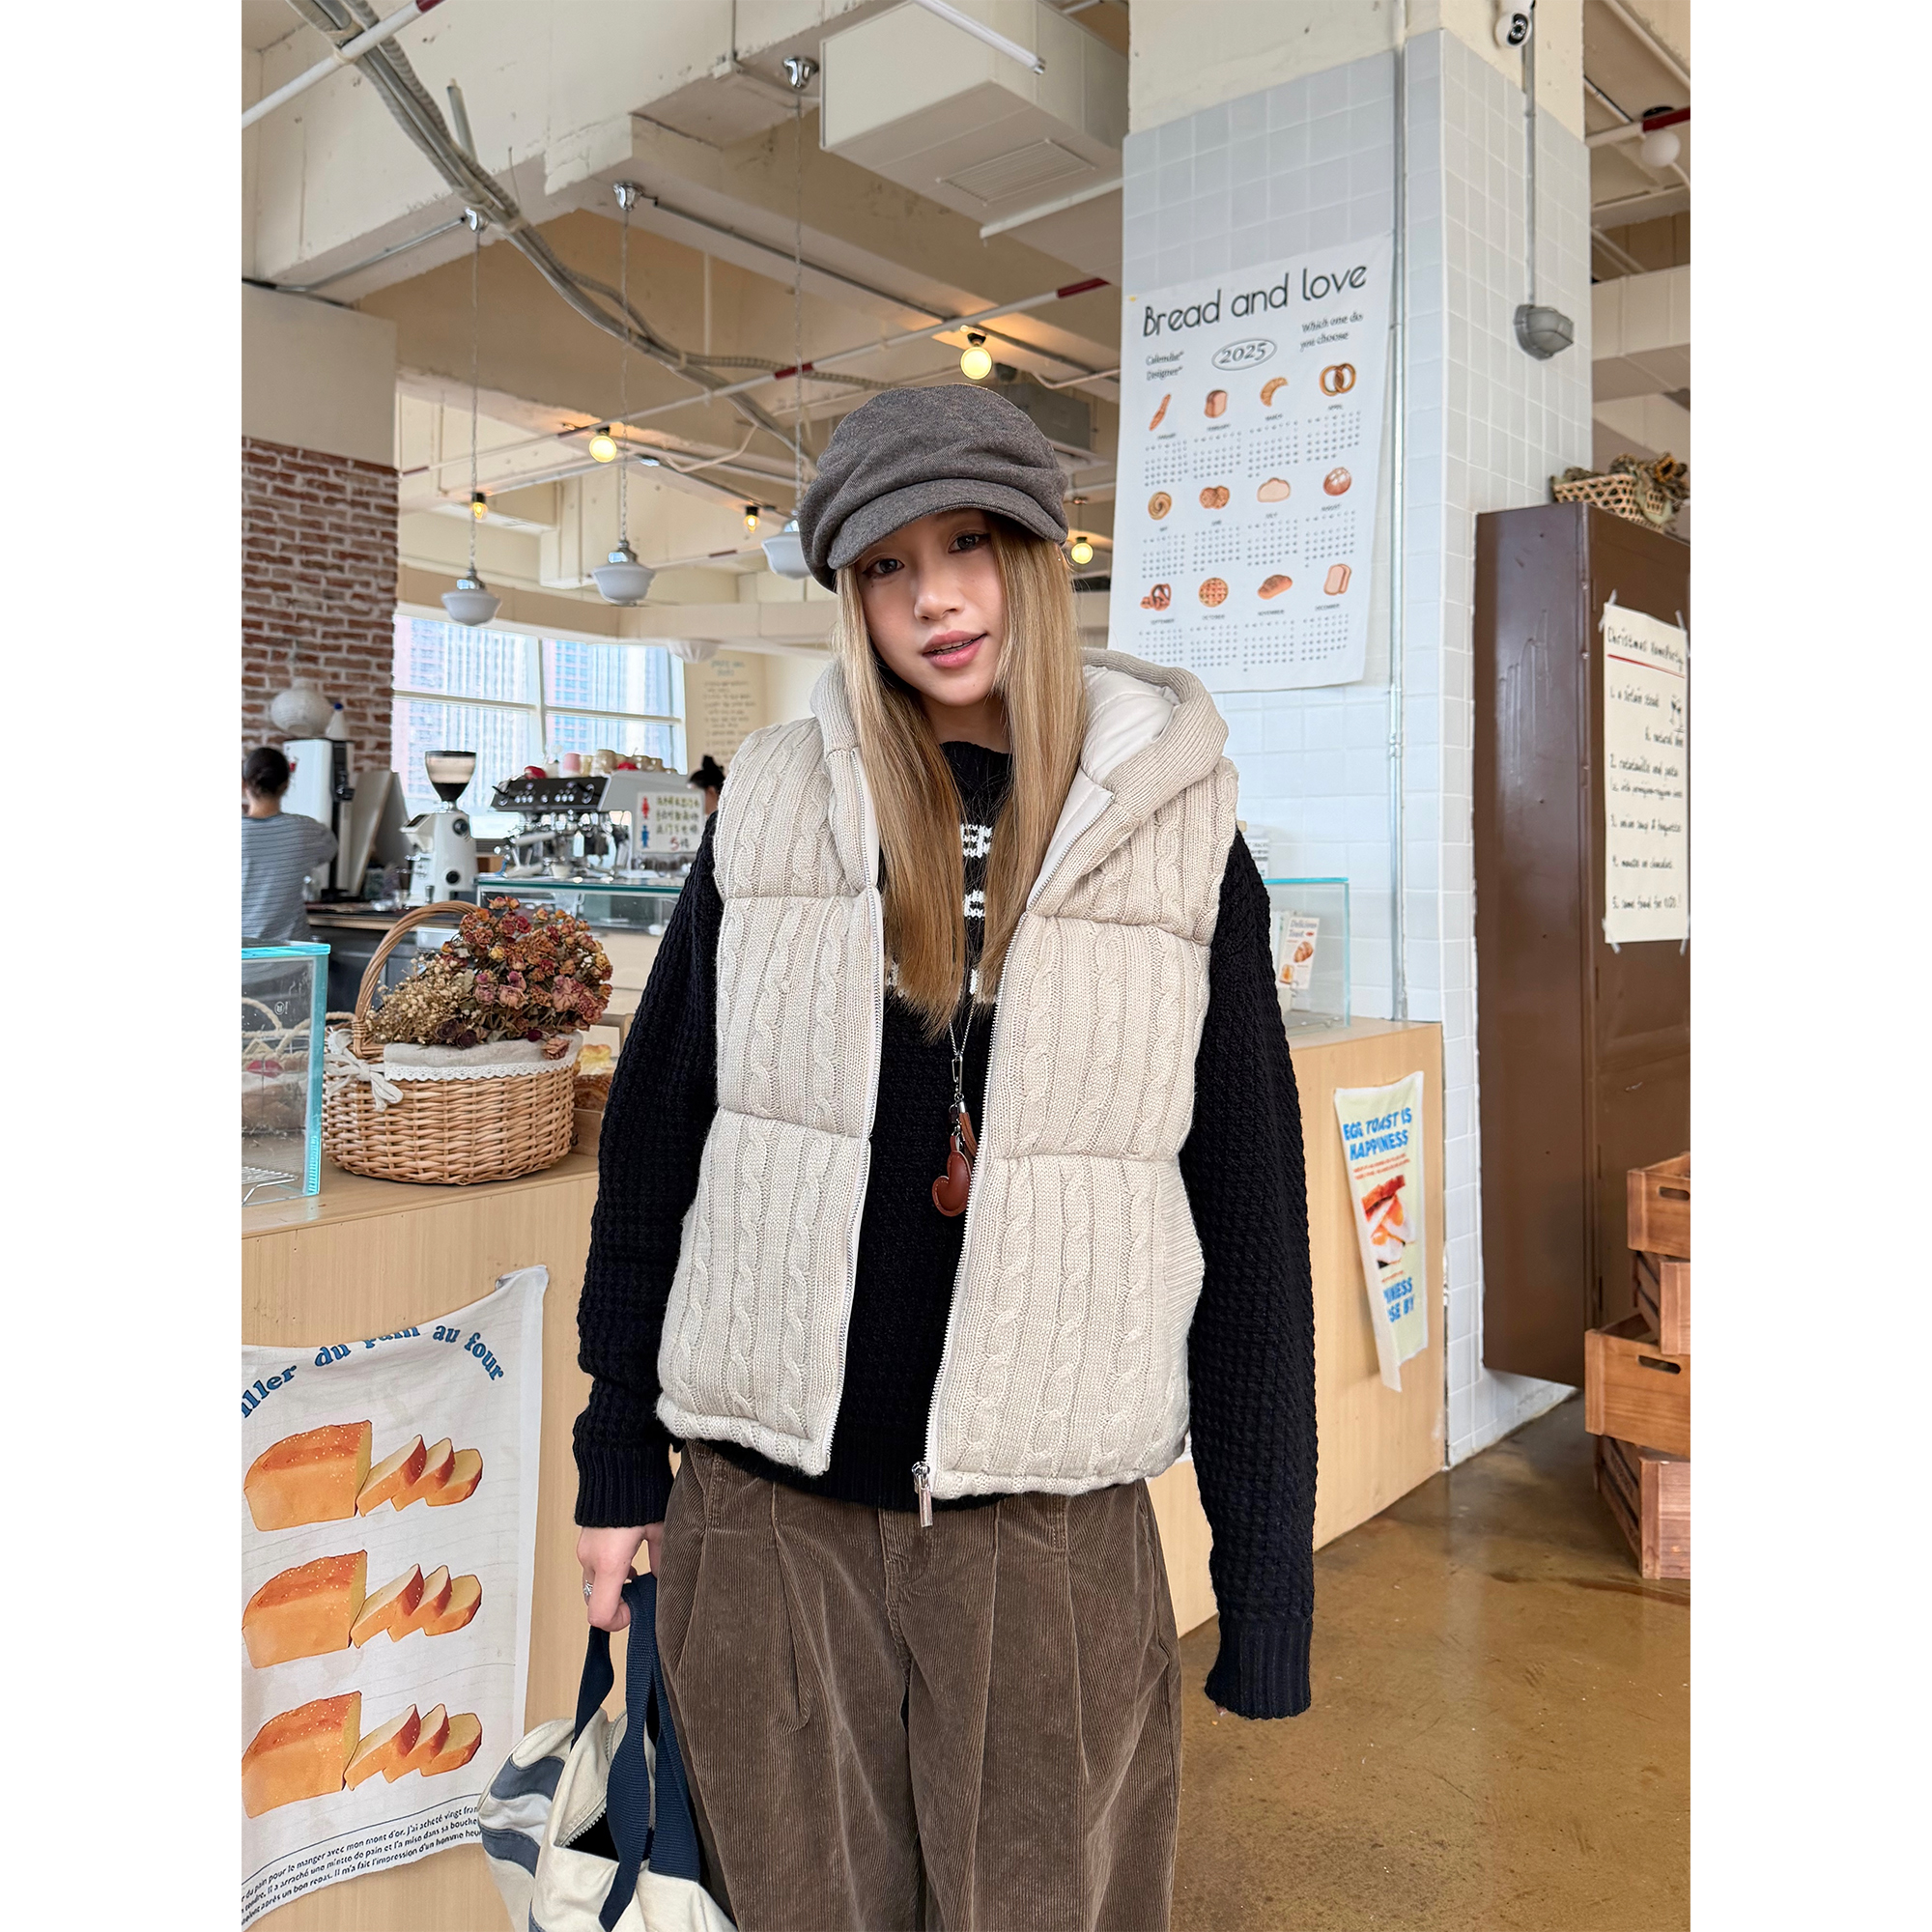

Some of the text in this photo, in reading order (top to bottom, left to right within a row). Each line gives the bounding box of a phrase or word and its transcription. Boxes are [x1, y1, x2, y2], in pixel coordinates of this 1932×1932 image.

[1143, 266, 1367, 337] Bread and love
[1218, 341, 1268, 365] 2025
[1343, 1107, 1412, 1142] EGG TOAST IS
[1350, 1129, 1408, 1161] HAPPINESS
[314, 1344, 352, 1368] du
[433, 1324, 461, 1344] au
[464, 1331, 504, 1381] four
[268, 1868, 287, 1885] pour
[297, 1852, 326, 1869] manger
[327, 1846, 345, 1858] avec
[346, 1840, 364, 1852] mon
[365, 1833, 387, 1845] mont
[419, 1814, 443, 1830] acheté
[444, 1808, 462, 1820] vingt
[280, 1868, 309, 1889] arraché
[310, 1864, 326, 1875] une
[354, 1852, 364, 1861] de
[365, 1846, 383, 1859] pain
[405, 1834, 422, 1846] mise
[423, 1829, 440, 1839] dans
[450, 1817, 477, 1830] bouche
[282, 1889, 293, 1899] un
[293, 1882, 309, 1893] bon
[357, 1861, 370, 1870] fait
[372, 1848, 417, 1866] l'impression
[435, 1833, 464, 1846] homme
